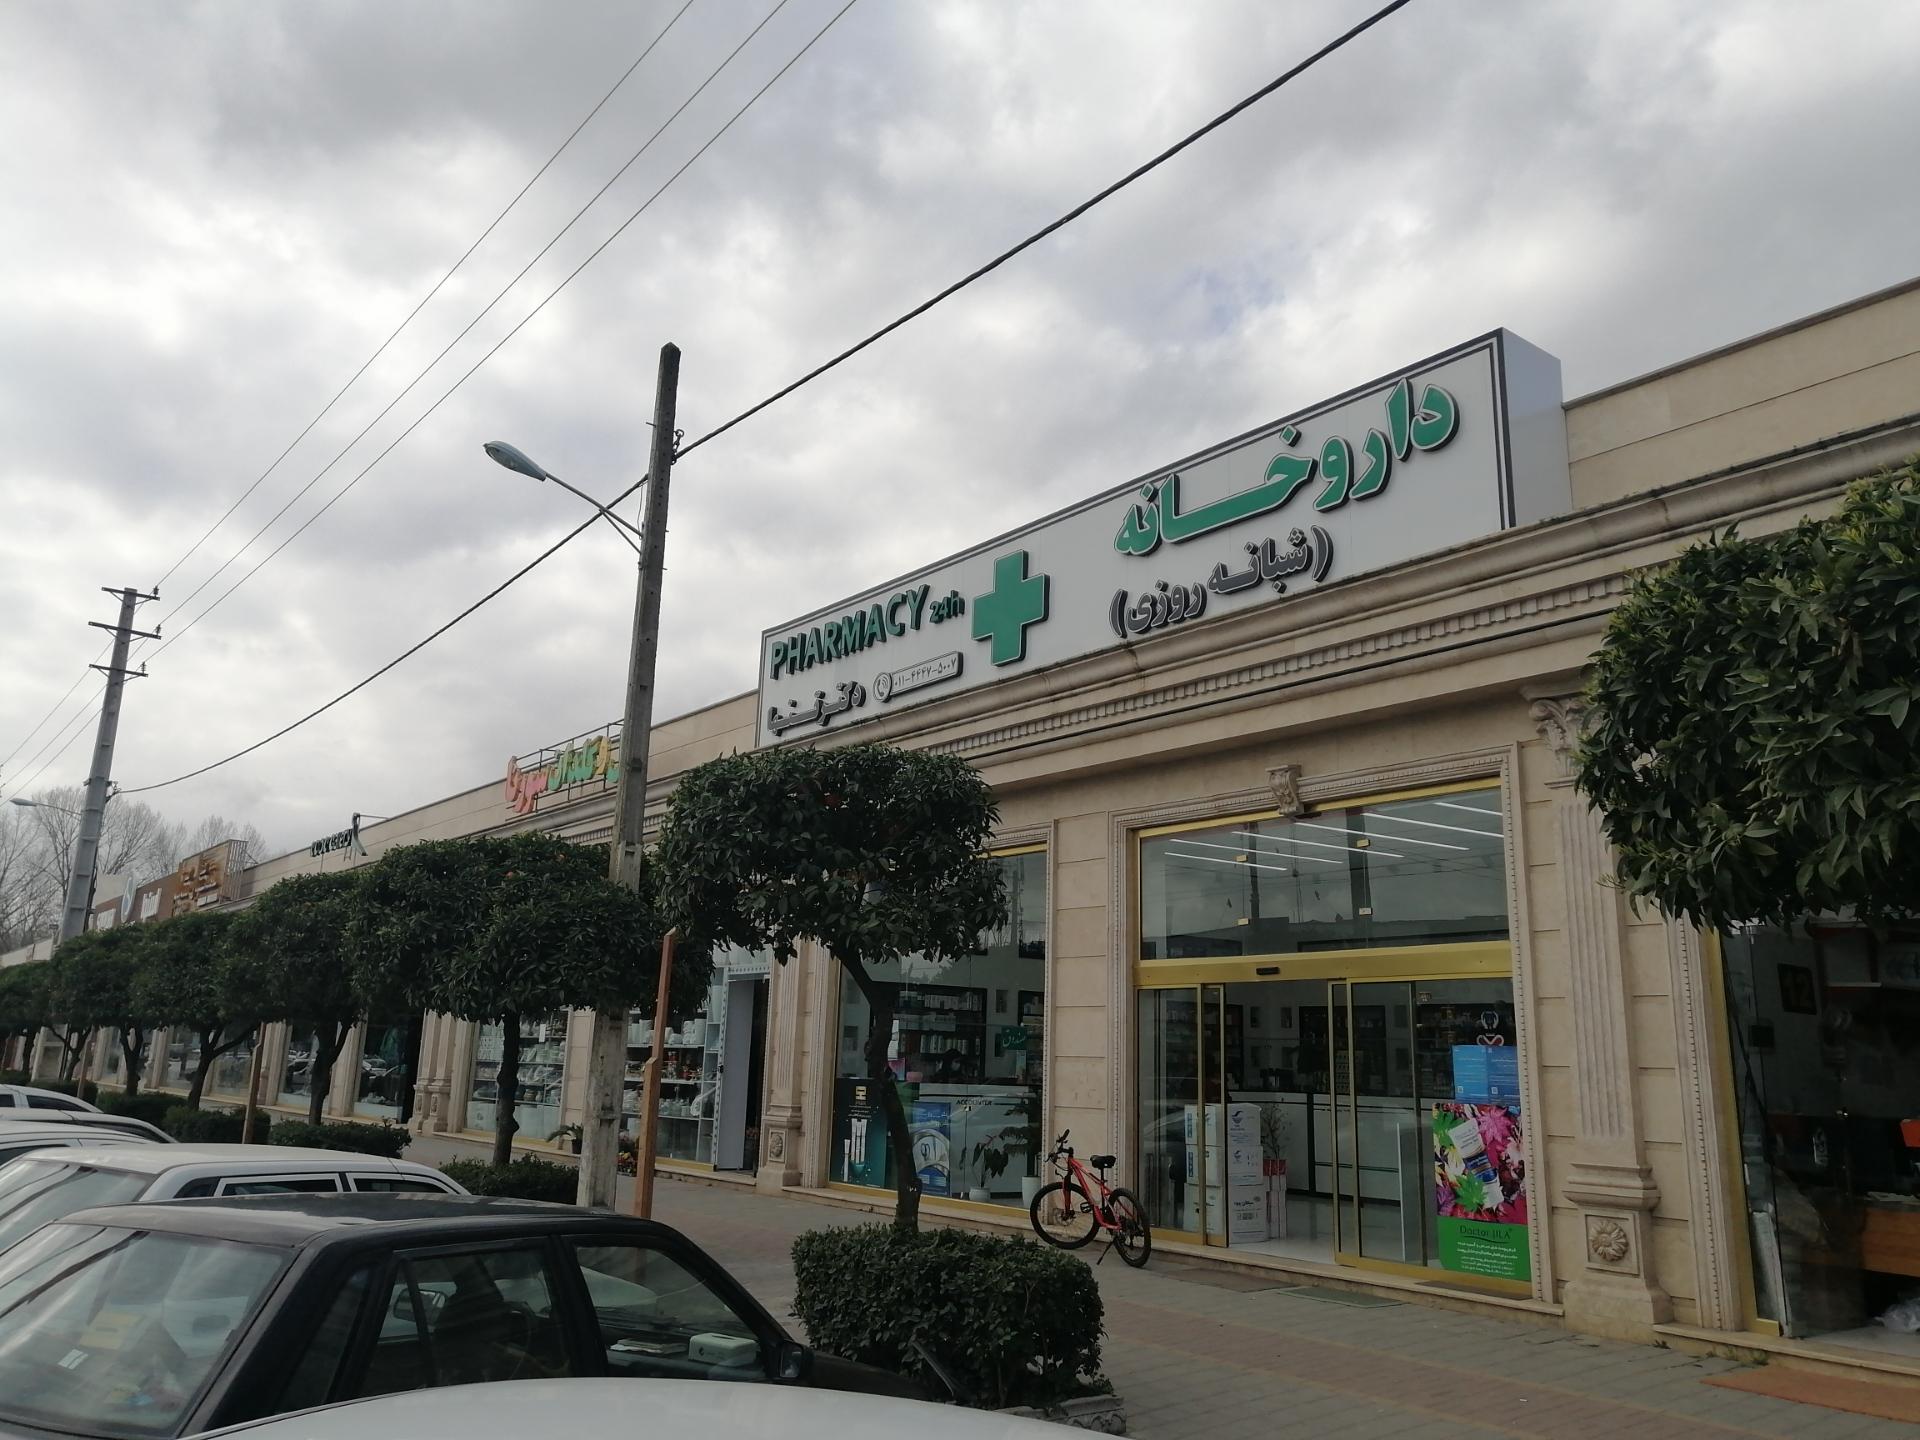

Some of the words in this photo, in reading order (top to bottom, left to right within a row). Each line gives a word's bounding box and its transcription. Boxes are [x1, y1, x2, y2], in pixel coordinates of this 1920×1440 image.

[1114, 378, 1459, 557] داروخانه
[1207, 524, 1334, 594] (شبانه
[769, 583, 931, 680] PHARMACY
[929, 589, 966, 624] 24h
[1108, 579, 1208, 638] روزی)
[817, 681, 867, 727] دکتر
